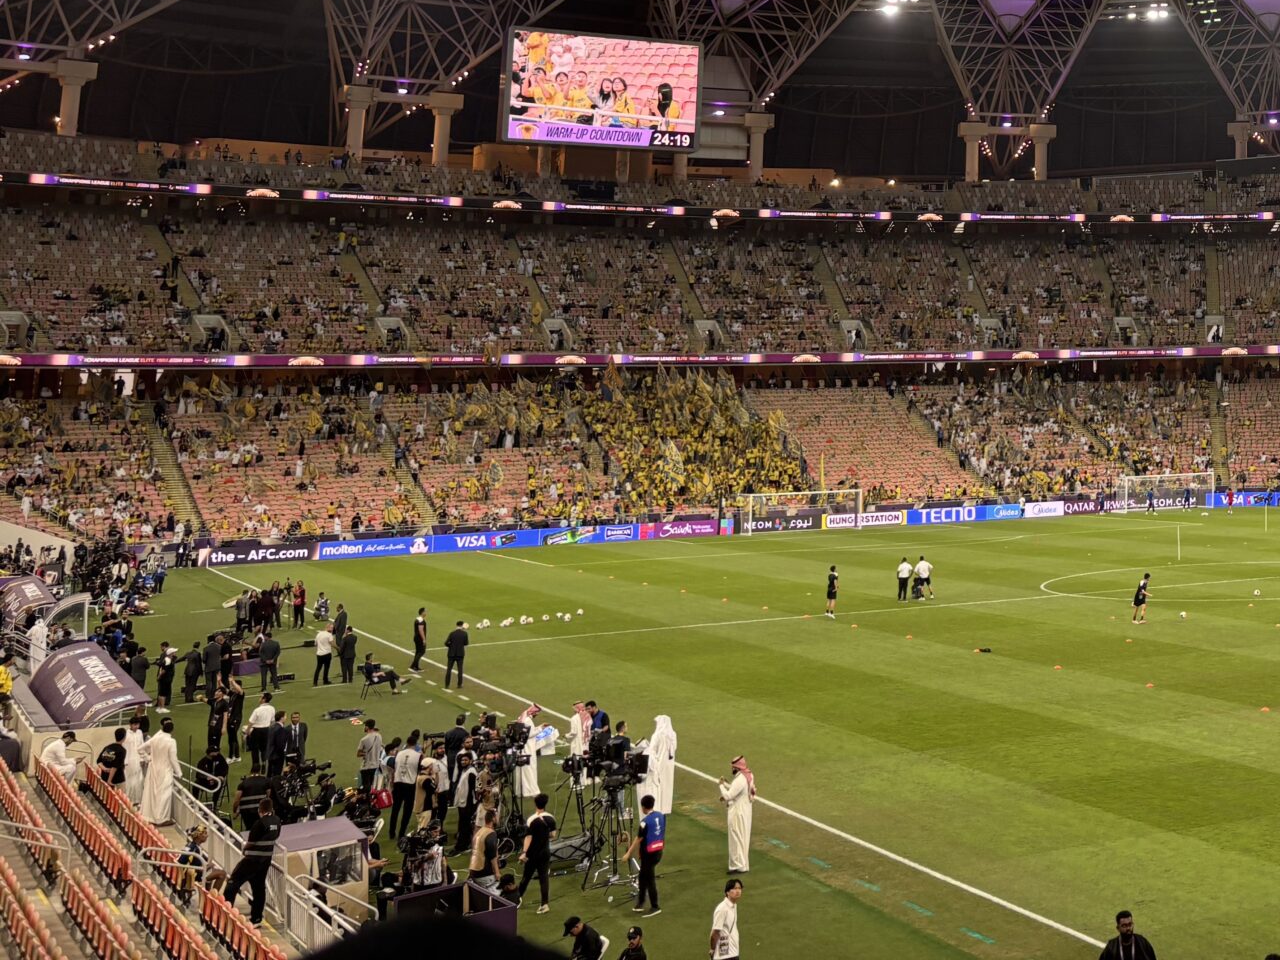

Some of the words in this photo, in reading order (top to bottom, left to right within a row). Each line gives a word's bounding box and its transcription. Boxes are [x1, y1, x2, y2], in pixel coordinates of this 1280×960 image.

[546, 126, 589, 140] WARM-UP
[589, 129, 643, 143] COUNTDOWN
[653, 132, 691, 147] 24:19
[1220, 495, 1244, 505] VSA
[919, 506, 976, 523] TECNO
[1065, 502, 1095, 514] QATAR
[829, 513, 900, 525] HUNGRSTATION
[454, 535, 487, 548] VISA
[211, 550, 235, 563] the
[247, 548, 309, 561] AFC.com
[322, 544, 363, 556] molten
